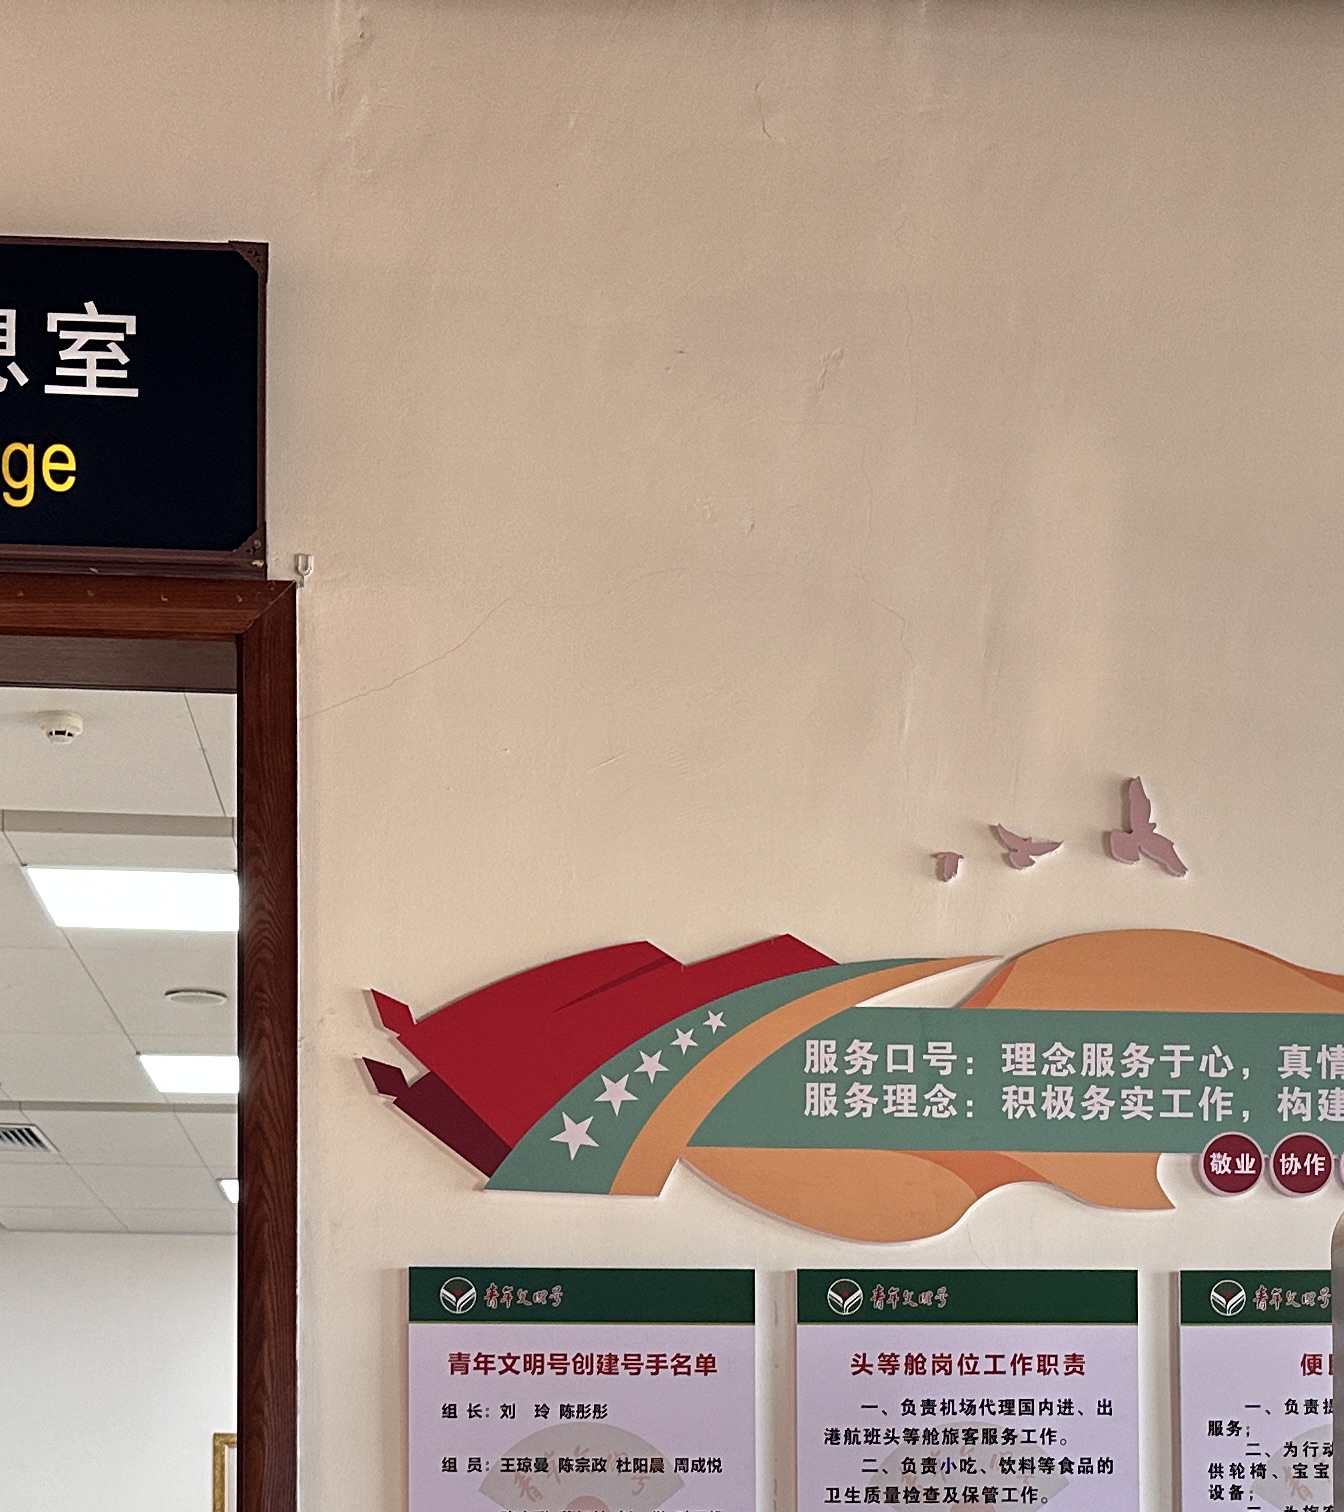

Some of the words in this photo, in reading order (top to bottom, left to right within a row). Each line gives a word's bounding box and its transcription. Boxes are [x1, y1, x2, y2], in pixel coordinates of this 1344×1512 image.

[1210, 1152, 1256, 1175] 敬业
[1279, 1154, 1326, 1176] 协作
[447, 1352, 718, 1377] 青年文明号创建号手名单
[851, 1353, 1087, 1377] 头等舱岗位工作职责
[1301, 1353, 1334, 1376] 便
[861, 1398, 1114, 1418] 一、负责机场代理国内进、出
[824, 1428, 1068, 1446] 港航班头等舱旅客服务工作。
[559, 1457, 607, 1473] 陈宗政
[616, 1457, 665, 1473] 杜阳晨
[674, 1457, 723, 1473] 周成悦
[861, 1457, 1114, 1476] 二、负责小吃、饮料等食品的
[1208, 1463, 1330, 1479] 供轮椅、宝宝
[825, 1486, 1049, 1505] 卫生质量检查及保管工作。
